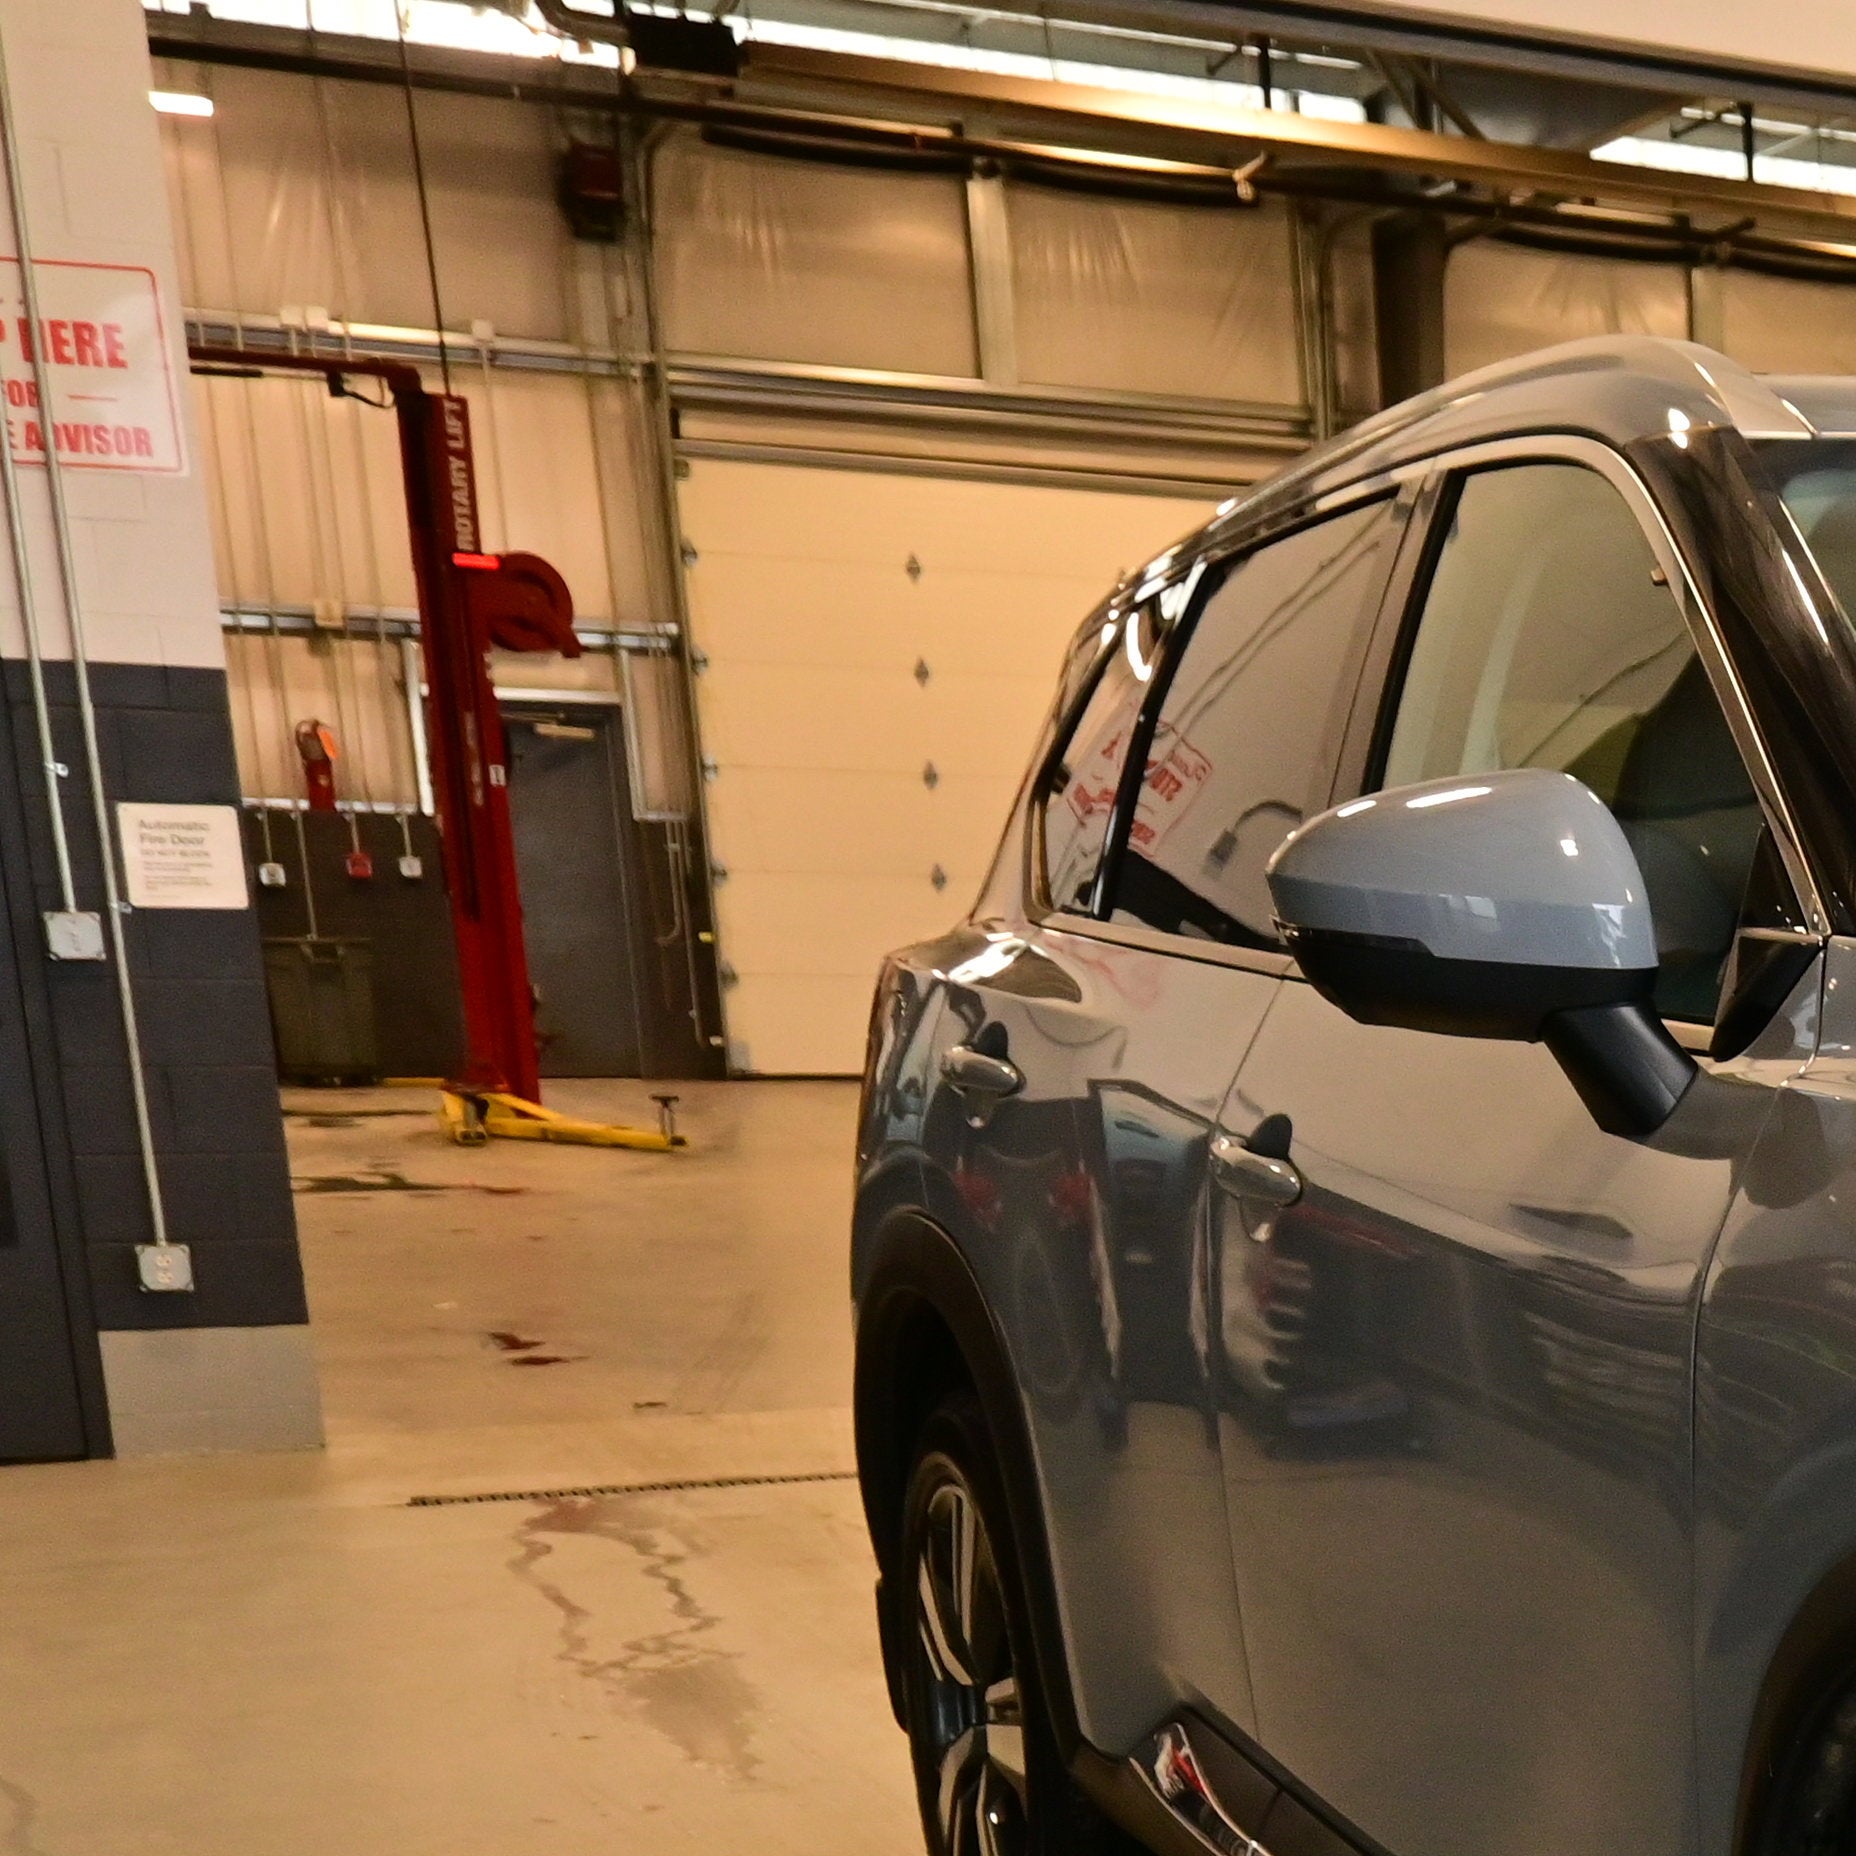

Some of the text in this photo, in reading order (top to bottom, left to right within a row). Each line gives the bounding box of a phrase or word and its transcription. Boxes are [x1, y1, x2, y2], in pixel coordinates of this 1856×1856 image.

[17, 318, 128, 369] HERE
[443, 398, 475, 552] ROTARY LIFT
